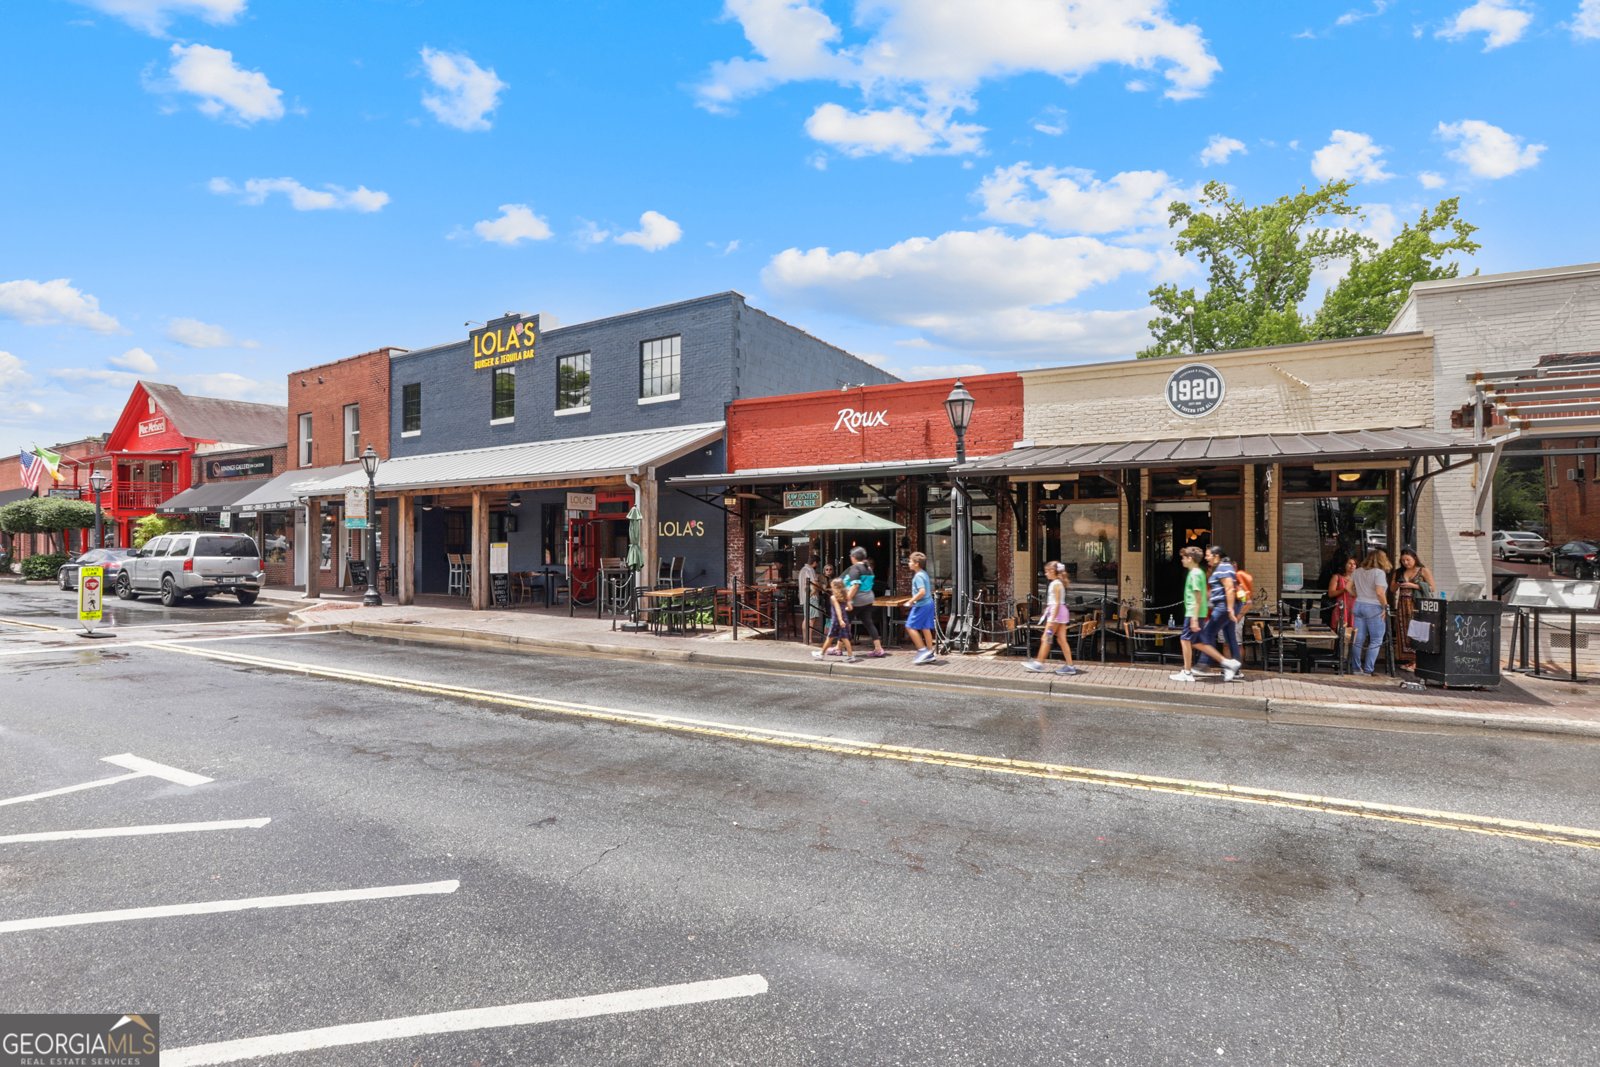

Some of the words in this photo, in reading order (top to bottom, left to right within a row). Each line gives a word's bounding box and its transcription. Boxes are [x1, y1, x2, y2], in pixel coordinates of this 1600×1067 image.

[474, 321, 535, 357] LOLA'S
[474, 357, 494, 370] BURGER
[494, 356, 500, 365] &
[500, 351, 522, 365] TEQUILA
[522, 349, 534, 360] BAR
[1170, 378, 1219, 402] 1920
[833, 407, 890, 434] Roux
[570, 495, 593, 505] LOLA'S
[658, 519, 705, 537] LOLA'S
[1421, 601, 1439, 612] 1920
